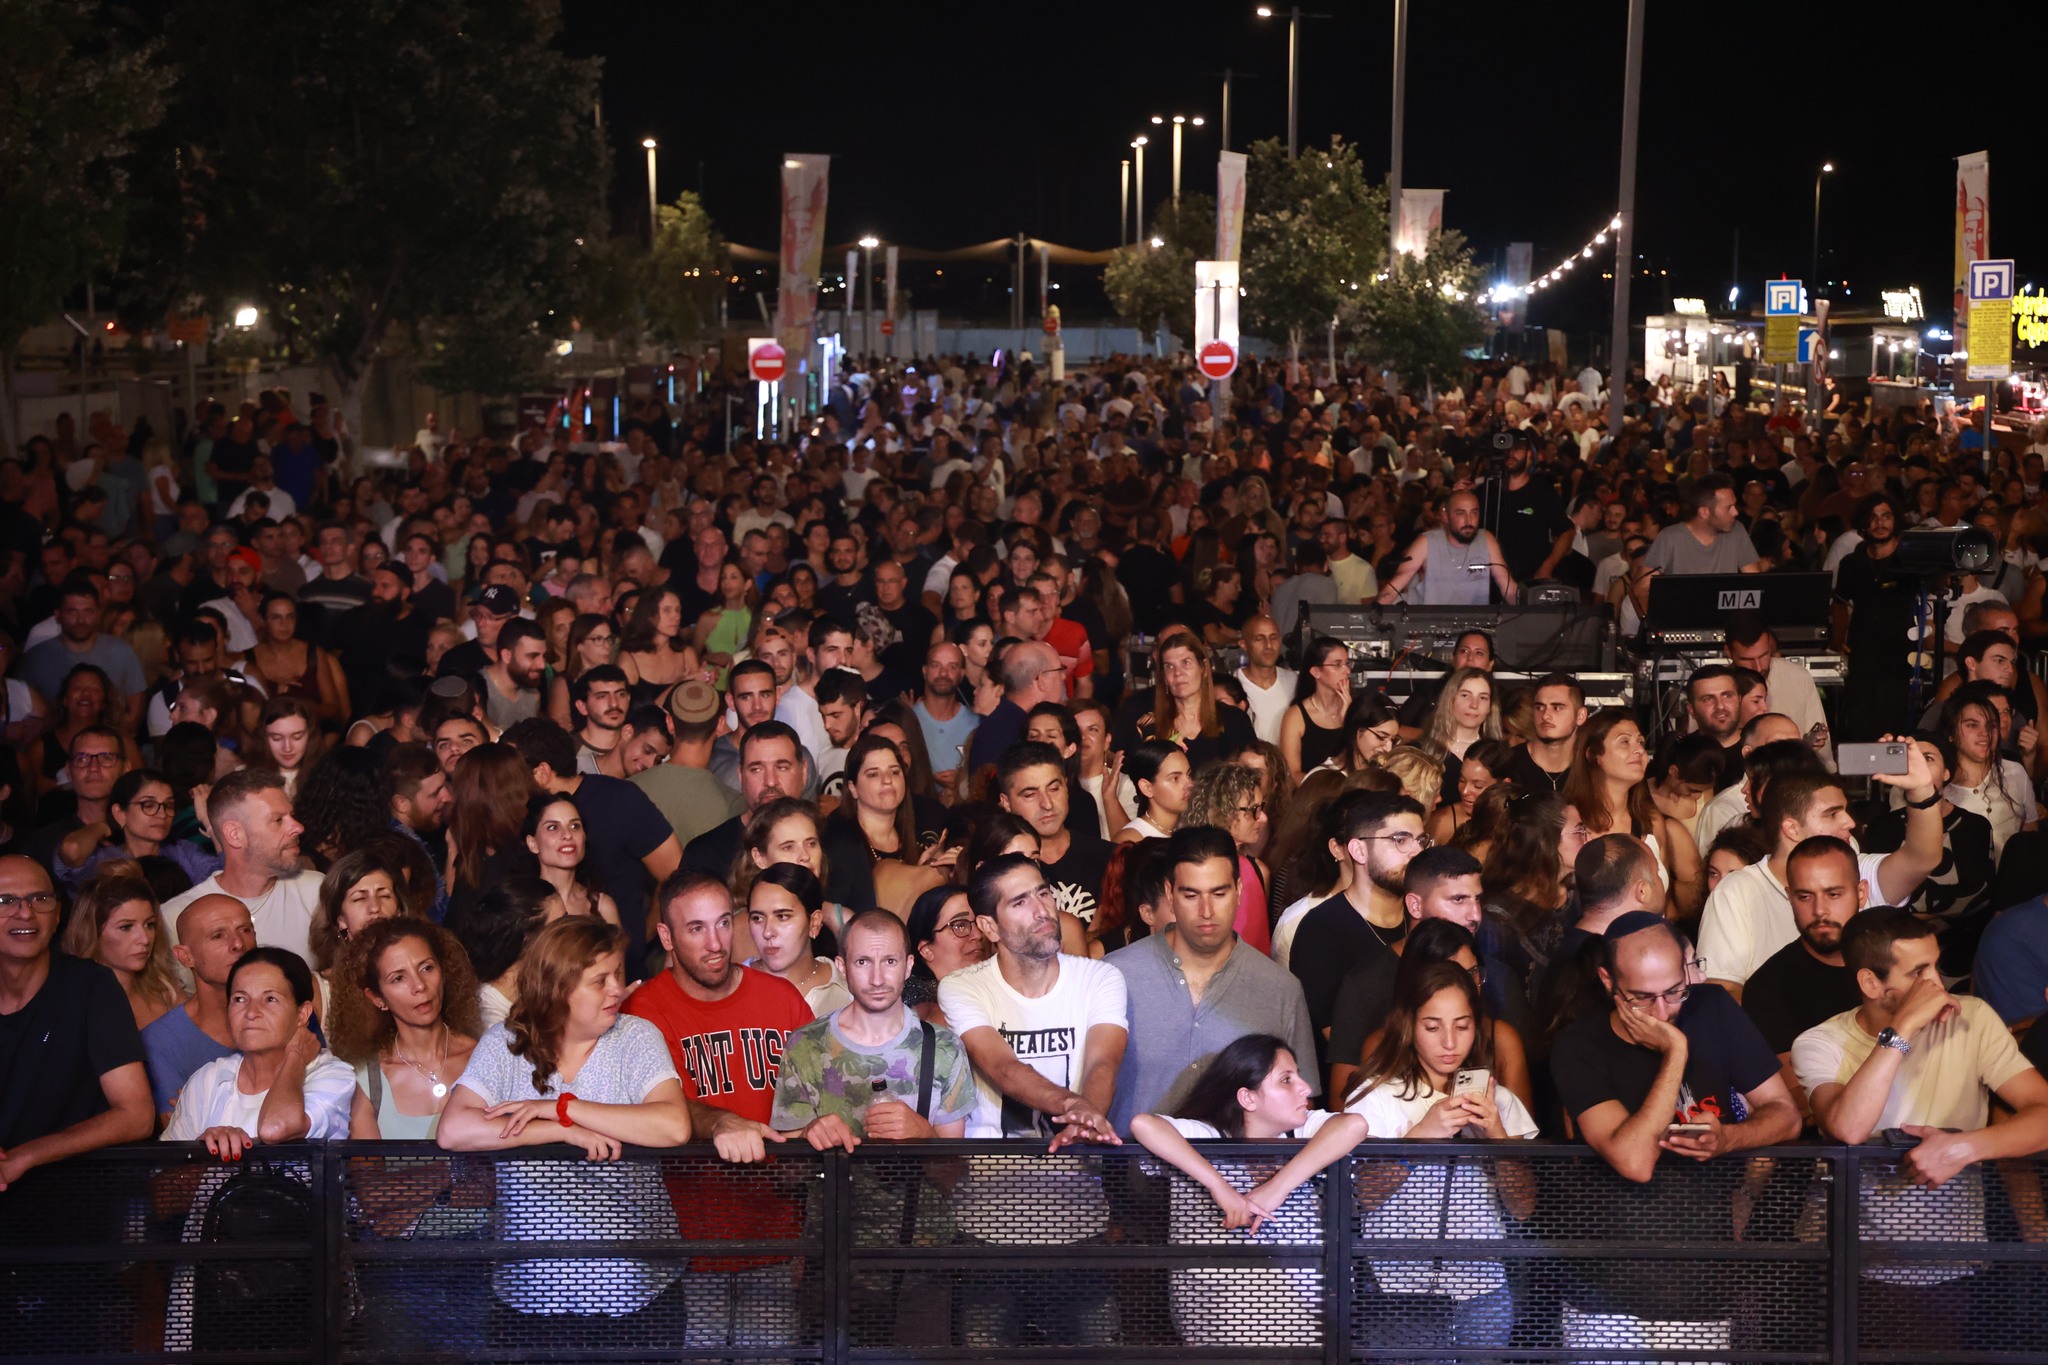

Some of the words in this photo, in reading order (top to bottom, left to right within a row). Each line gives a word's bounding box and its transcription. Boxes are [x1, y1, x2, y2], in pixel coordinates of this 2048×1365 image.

[1721, 592, 1756, 608] MA
[997, 1027, 1075, 1054] REATEST
[739, 1028, 792, 1091] US
